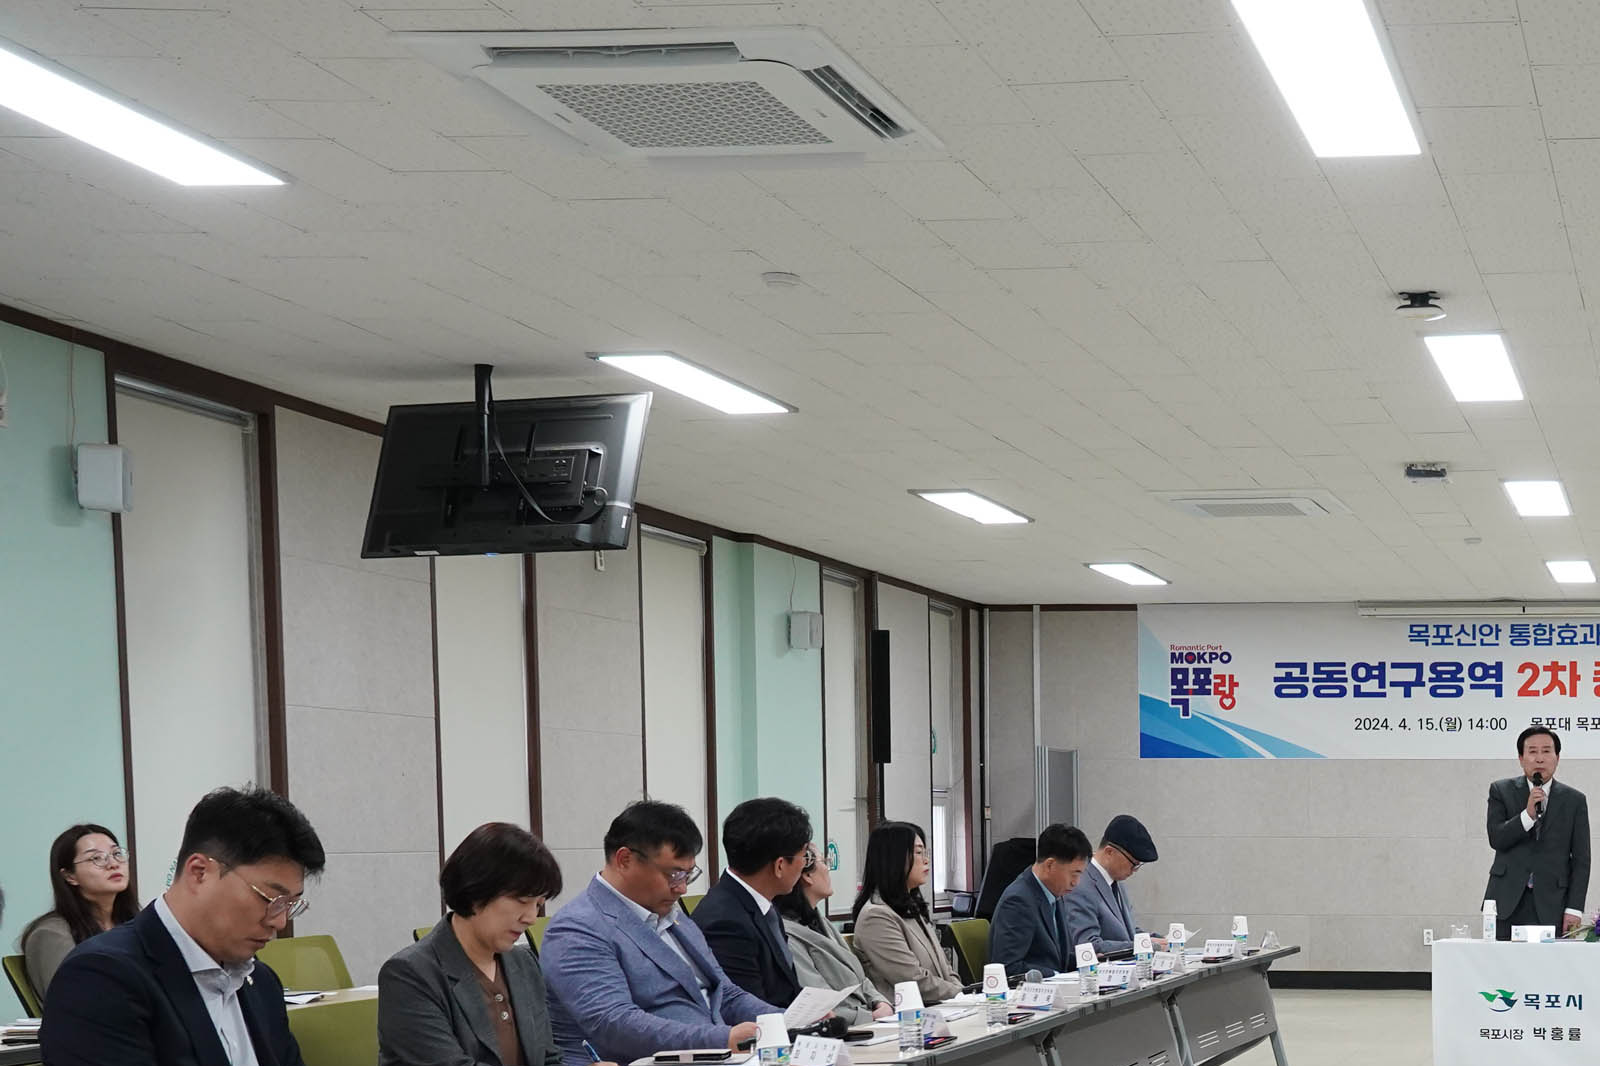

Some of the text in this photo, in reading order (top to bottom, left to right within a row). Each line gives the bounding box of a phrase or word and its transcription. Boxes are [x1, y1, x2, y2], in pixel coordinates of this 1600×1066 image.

[1408, 623, 1502, 647] 목포신안
[1170, 652, 1232, 664] MOKPO
[1273, 661, 1504, 698] 공동연구용역
[1517, 660, 1581, 698] 2차
[1170, 668, 1239, 716] 목포랑
[1354, 717, 1393, 731] 2024.
[1398, 717, 1412, 731] 4.
[1417, 716, 1462, 732] 15.(월)
[1468, 717, 1508, 731] 14:00
[1523, 994, 1583, 1010] 목포시
[1480, 1028, 1524, 1040] 목포시장
